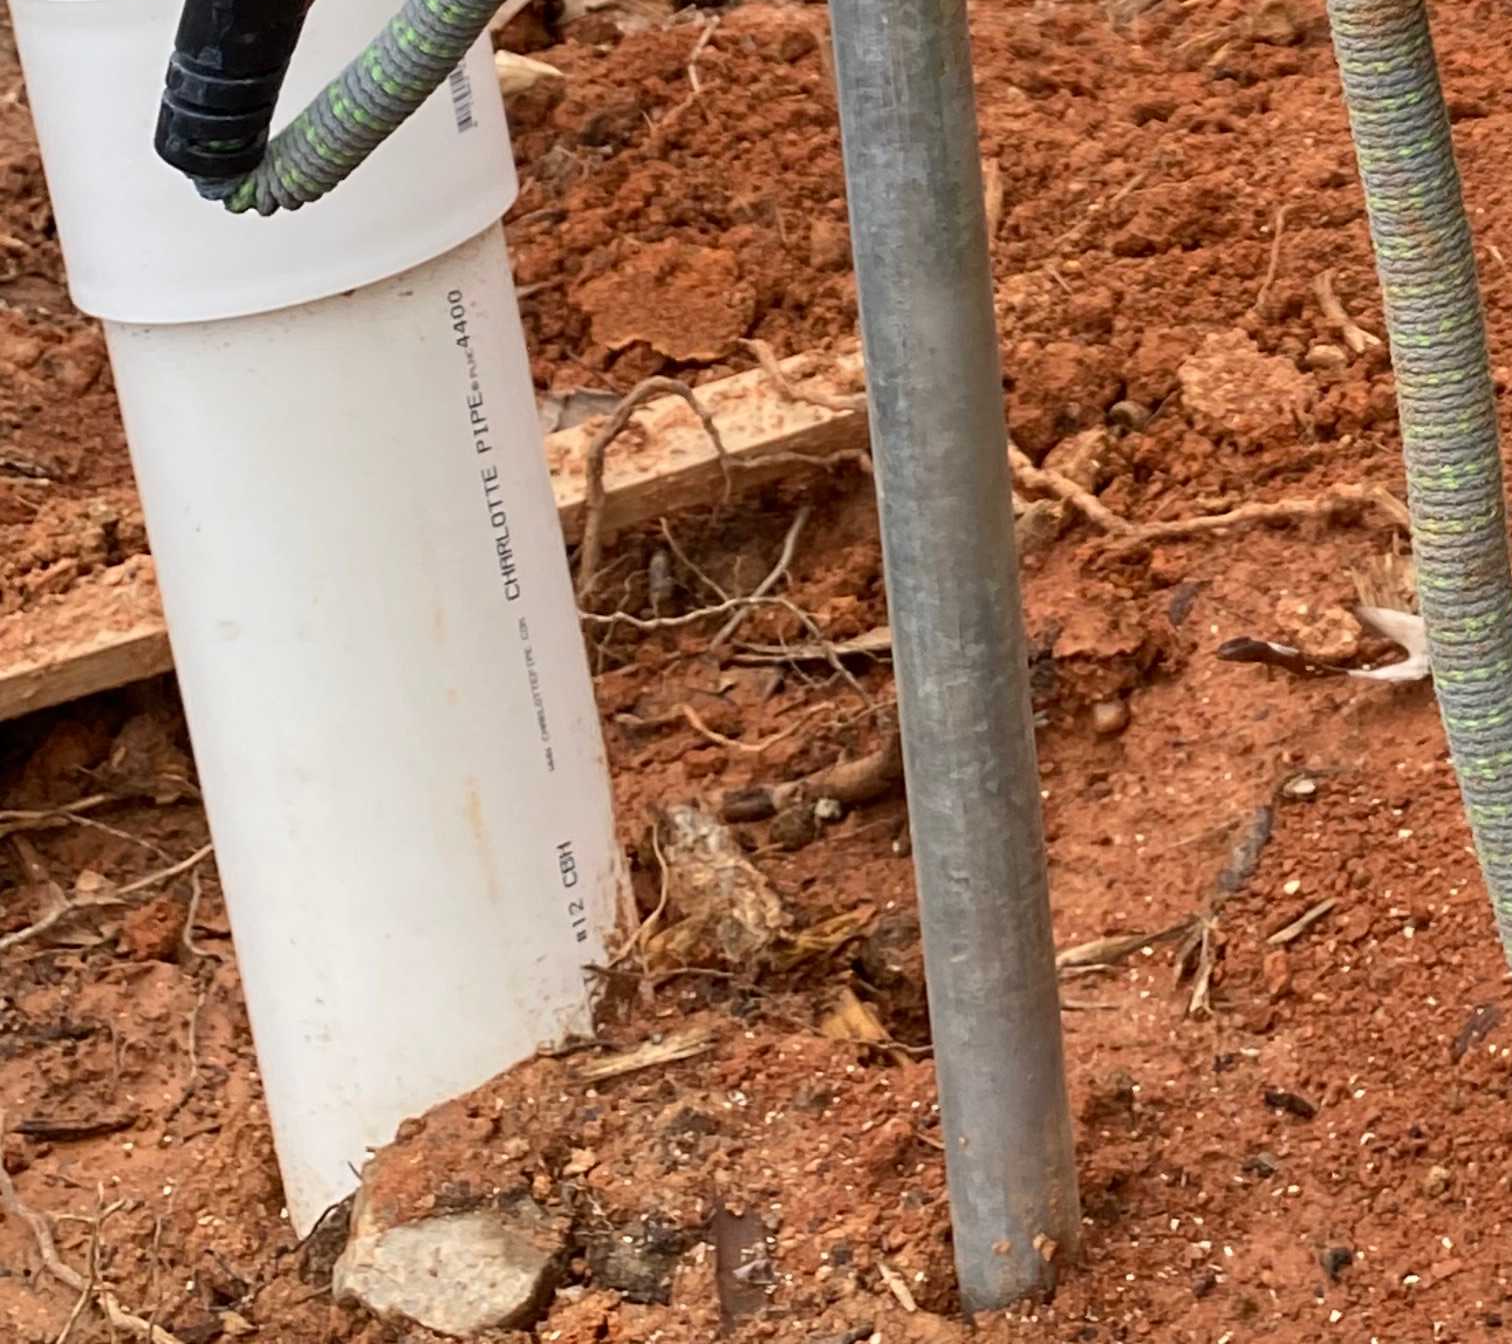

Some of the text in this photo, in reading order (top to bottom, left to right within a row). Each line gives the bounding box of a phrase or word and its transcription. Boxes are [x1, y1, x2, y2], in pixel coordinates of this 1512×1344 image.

[447, 289, 471, 349] 4400
[466, 391, 494, 455] PIPE
[481, 465, 521, 601] CHARLOTTE
